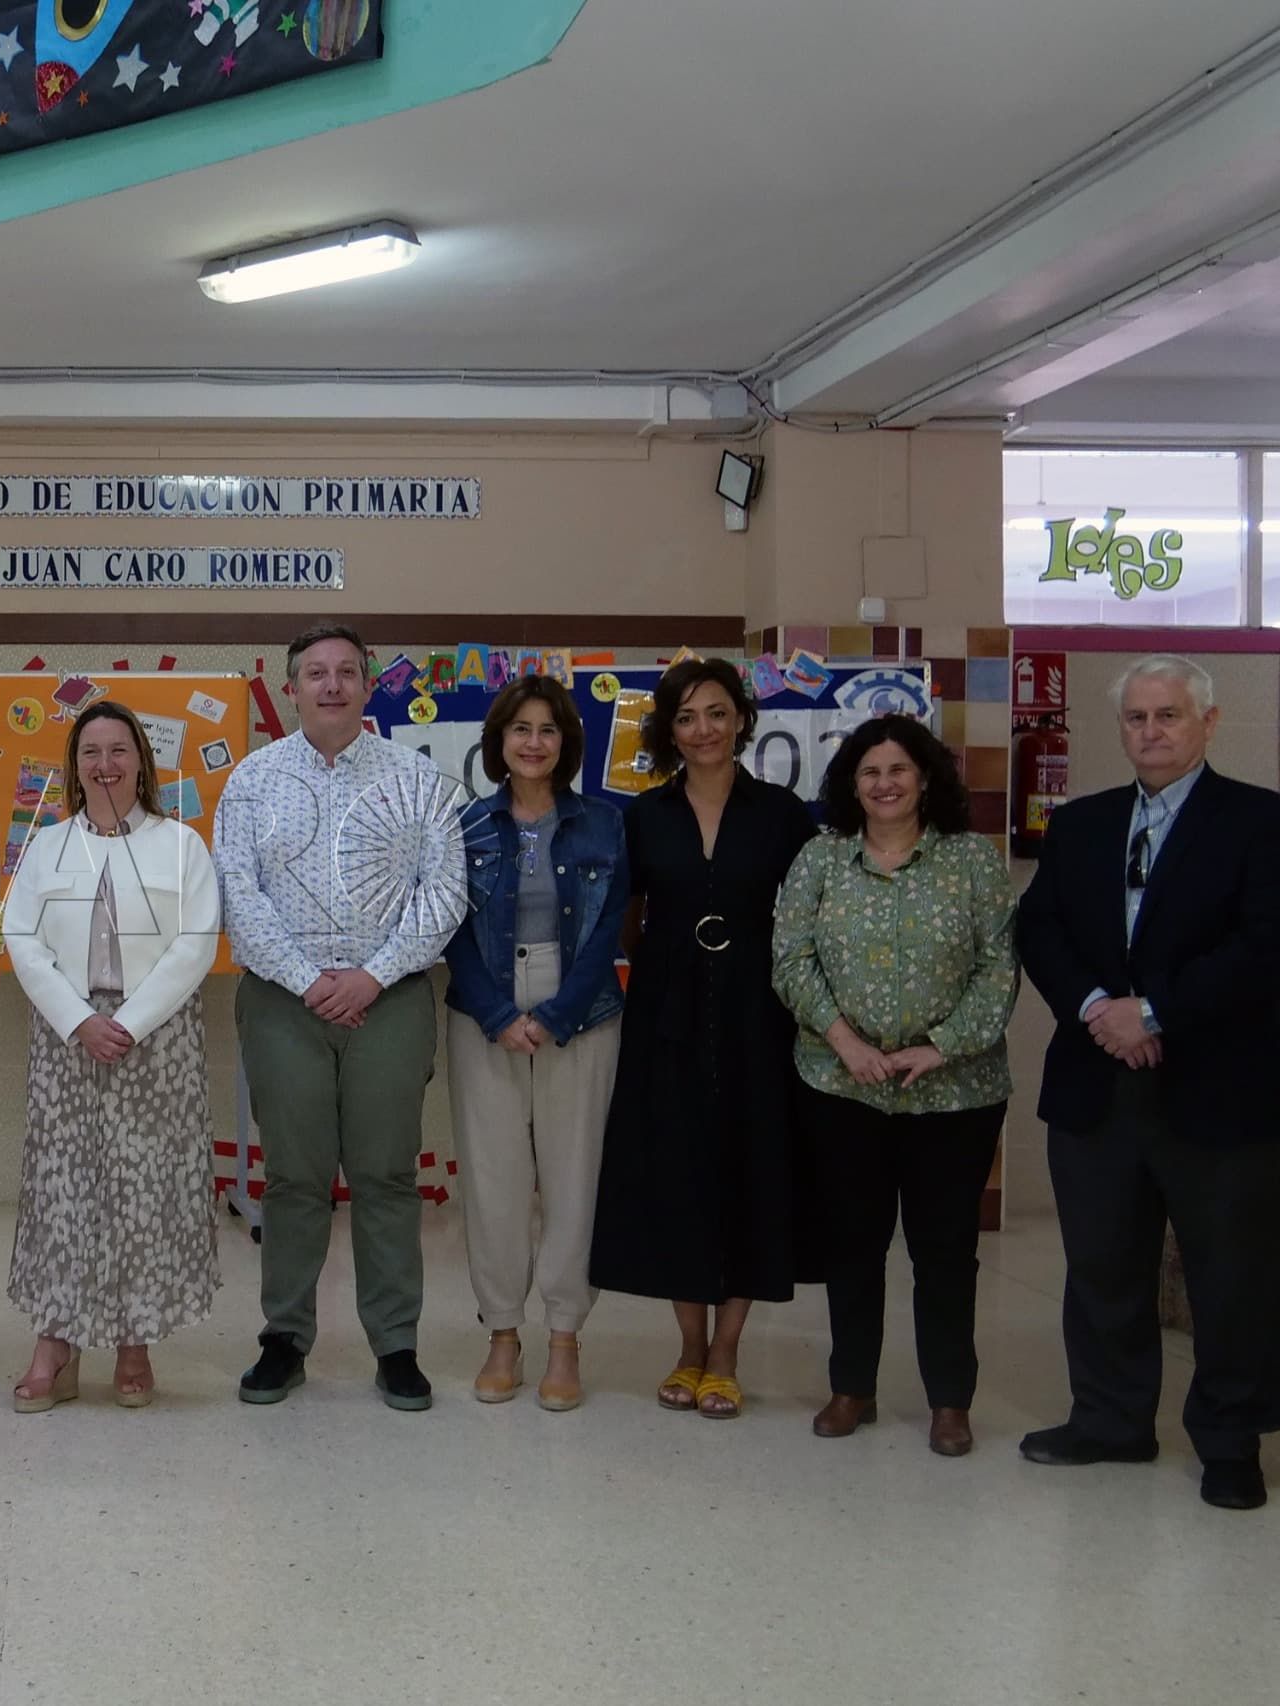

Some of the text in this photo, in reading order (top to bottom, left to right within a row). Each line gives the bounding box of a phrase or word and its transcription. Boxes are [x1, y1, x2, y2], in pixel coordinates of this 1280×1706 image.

[32, 481, 73, 512] DE
[95, 481, 281, 513] EDUCACION
[304, 483, 471, 514] PRIMARIA
[2, 552, 333, 584] JUAN CARO ROMERO
[1013, 714, 1064, 729] EXTOR
